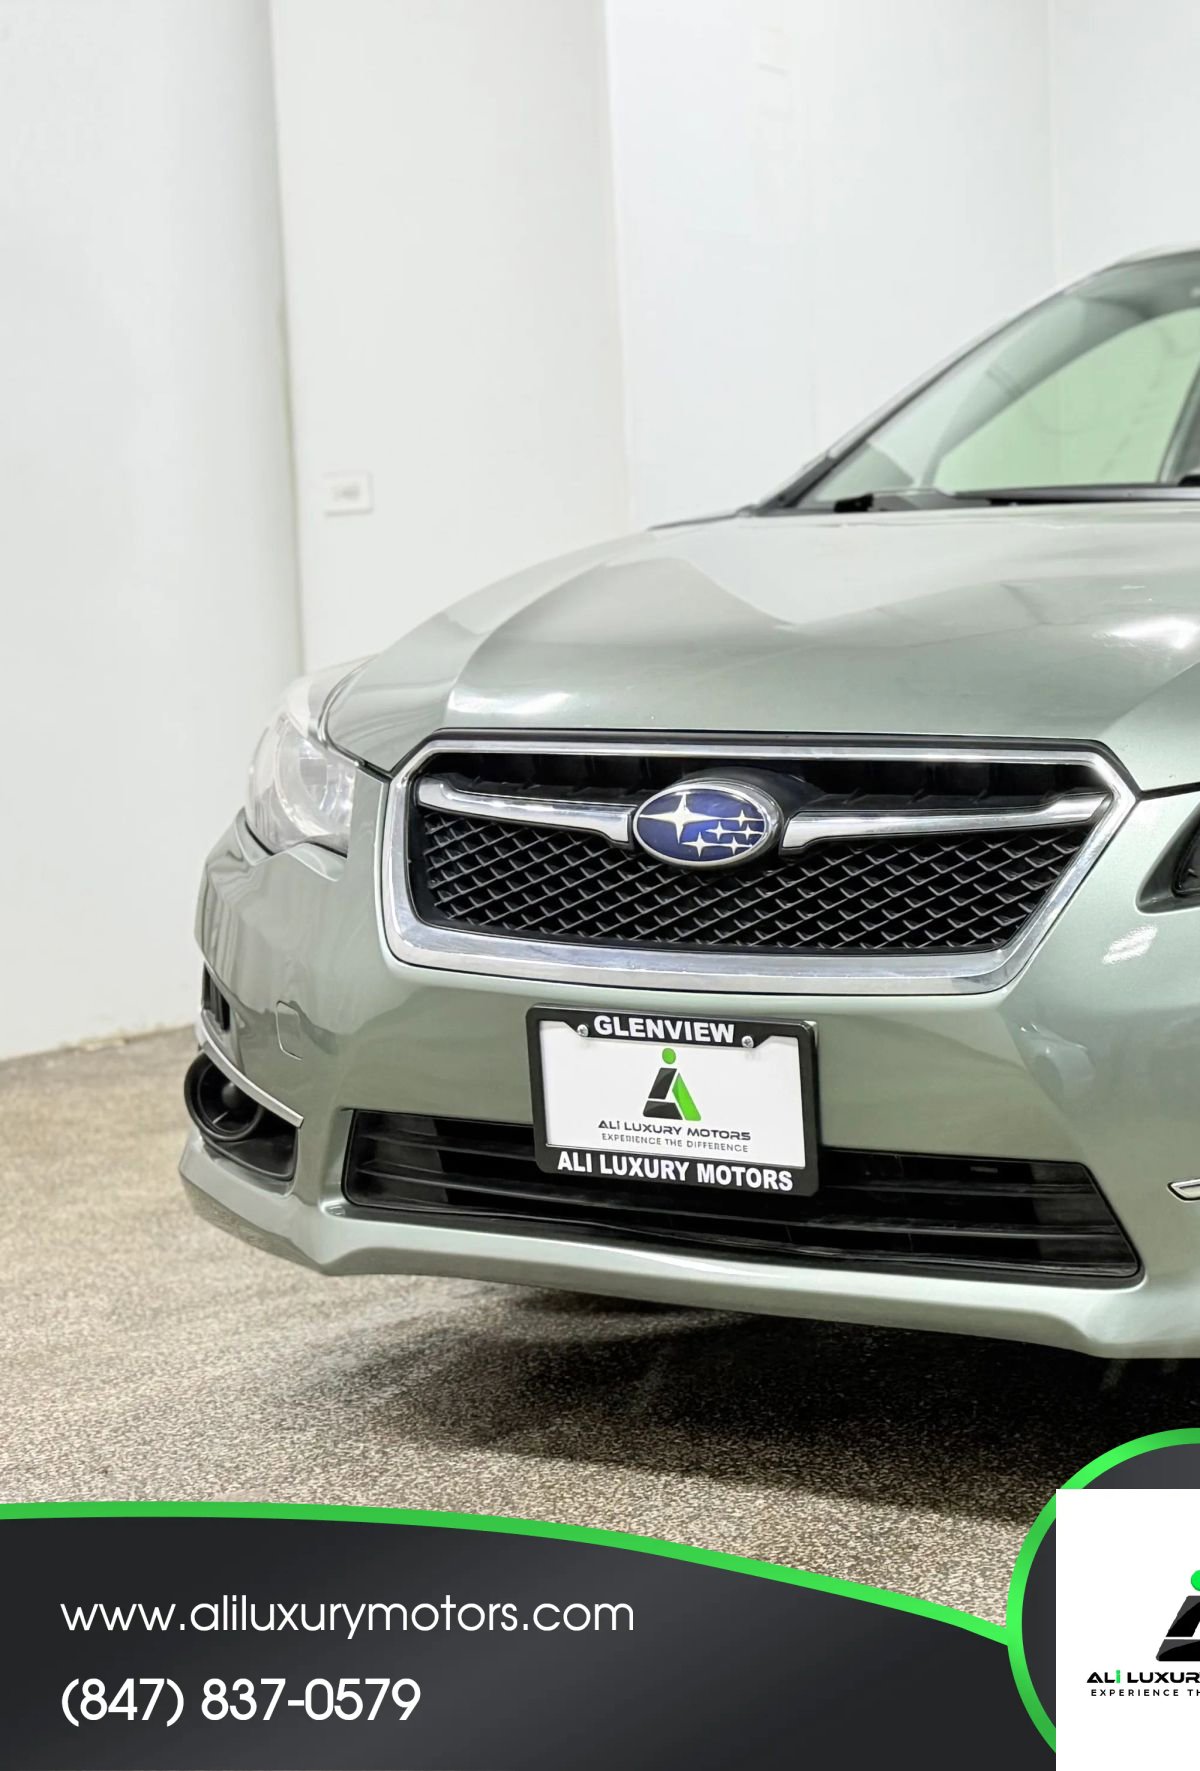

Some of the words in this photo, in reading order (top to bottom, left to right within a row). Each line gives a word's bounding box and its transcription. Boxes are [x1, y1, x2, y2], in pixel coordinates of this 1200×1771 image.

[593, 1014, 735, 1043] GLENVIEW
[601, 1132, 662, 1146] EXPERIENCE
[664, 1137, 683, 1148] THE
[686, 1140, 749, 1153] DIFFERENCE
[624, 1121, 683, 1135] LUXURY
[687, 1127, 752, 1141] MOTORS
[557, 1150, 593, 1173] ALI
[599, 1153, 690, 1181] LUXURY
[697, 1163, 794, 1192] MOTORS
